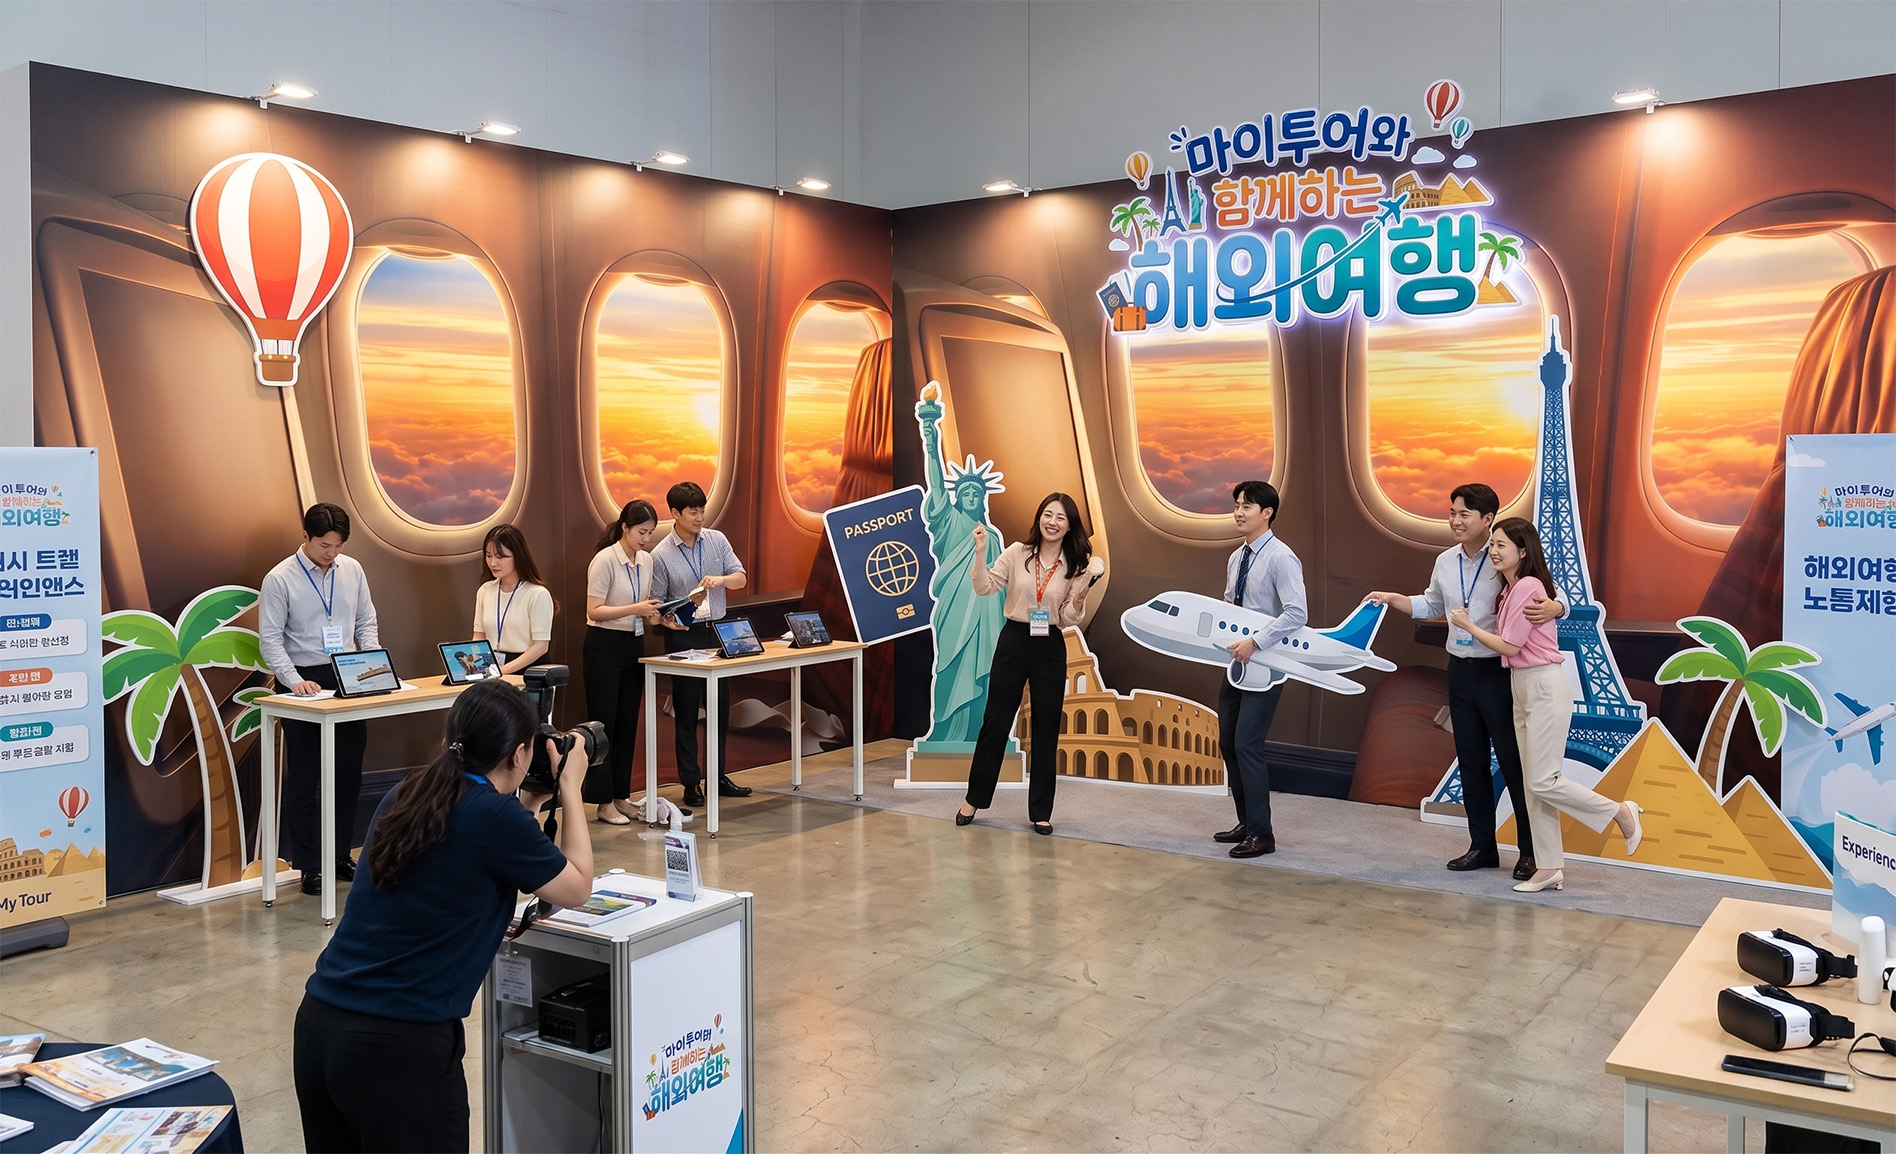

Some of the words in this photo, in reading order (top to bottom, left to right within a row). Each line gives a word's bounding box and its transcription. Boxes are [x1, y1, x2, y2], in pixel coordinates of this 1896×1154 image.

[1186, 107, 1411, 175] 마이투어와
[1213, 166, 1384, 227] 함께하는
[1130, 214, 1477, 328] 해외여행
[844, 508, 914, 539] PASSPORT
[1842, 834, 1896, 870] Experienc
[18, 891, 52, 907] Tour
